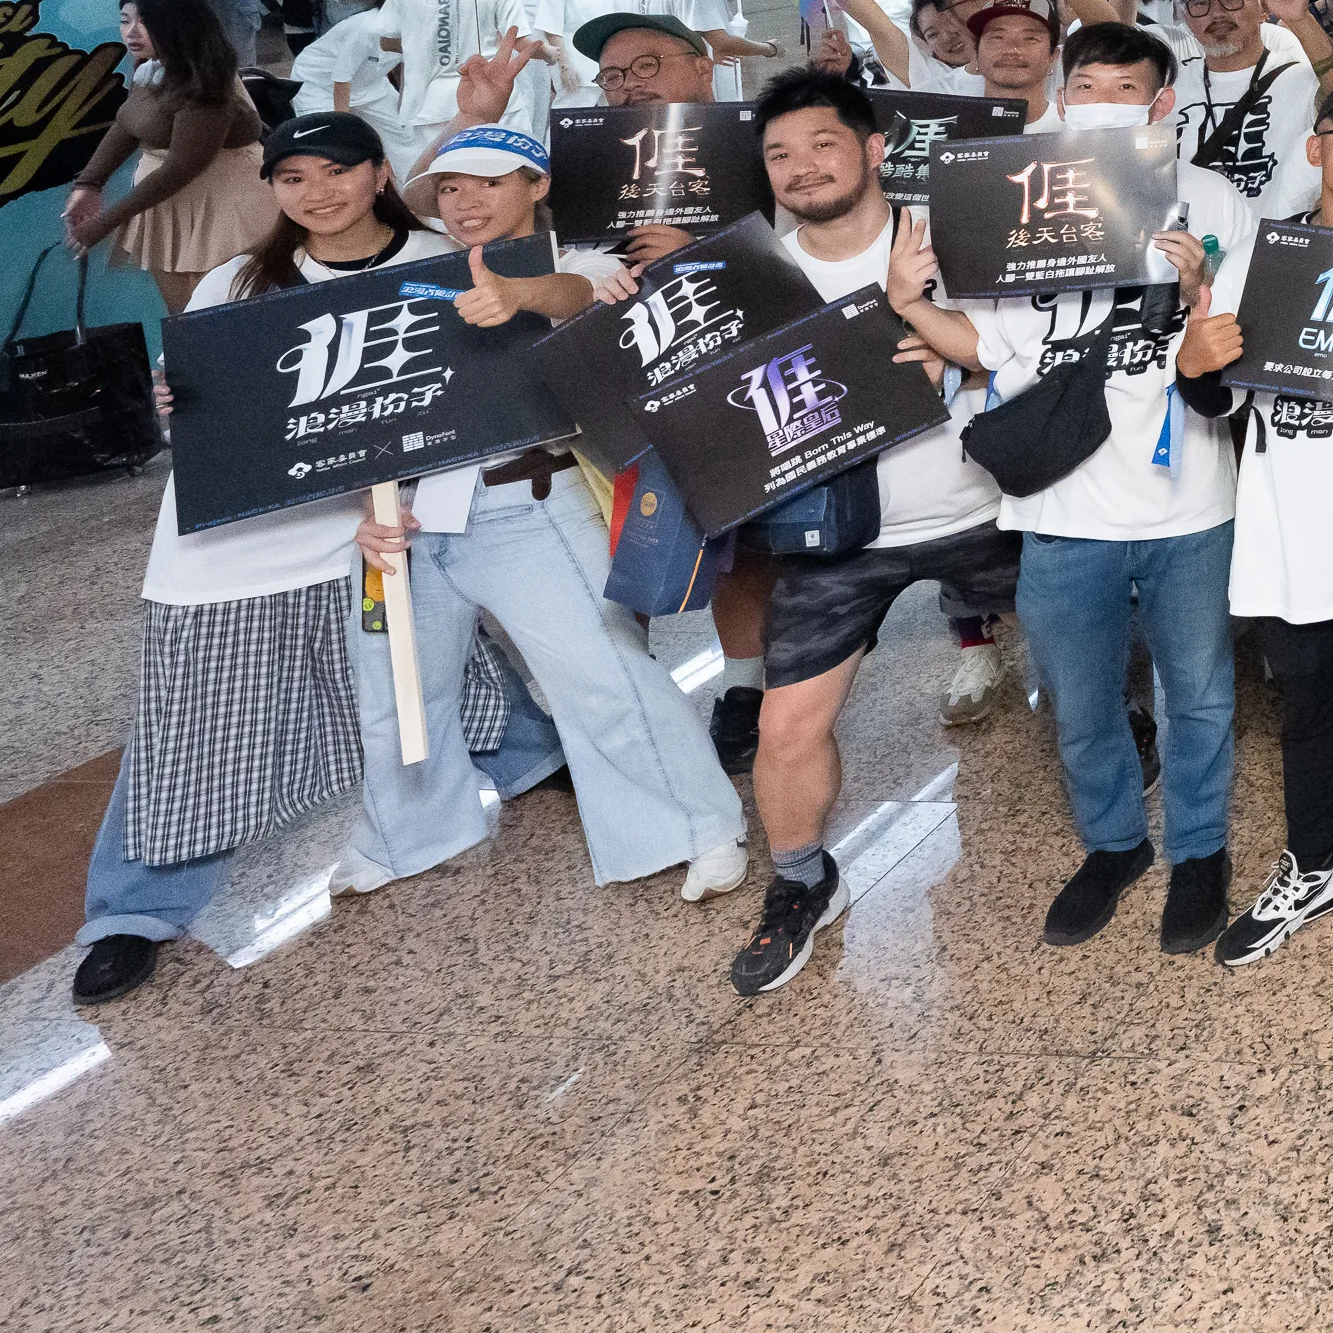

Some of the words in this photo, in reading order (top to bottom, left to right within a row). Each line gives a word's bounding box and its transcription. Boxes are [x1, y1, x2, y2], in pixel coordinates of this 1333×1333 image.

[618, 177, 711, 200] 後天台客
[1006, 217, 1105, 249] 後天台客
[647, 319, 744, 386] 浪漫份子
[285, 383, 445, 442] 浪漫份子
[804, 441, 829, 460] Born
[830, 431, 852, 449] This
[853, 420, 875, 441] Way
[1310, 428, 1328, 436] man
